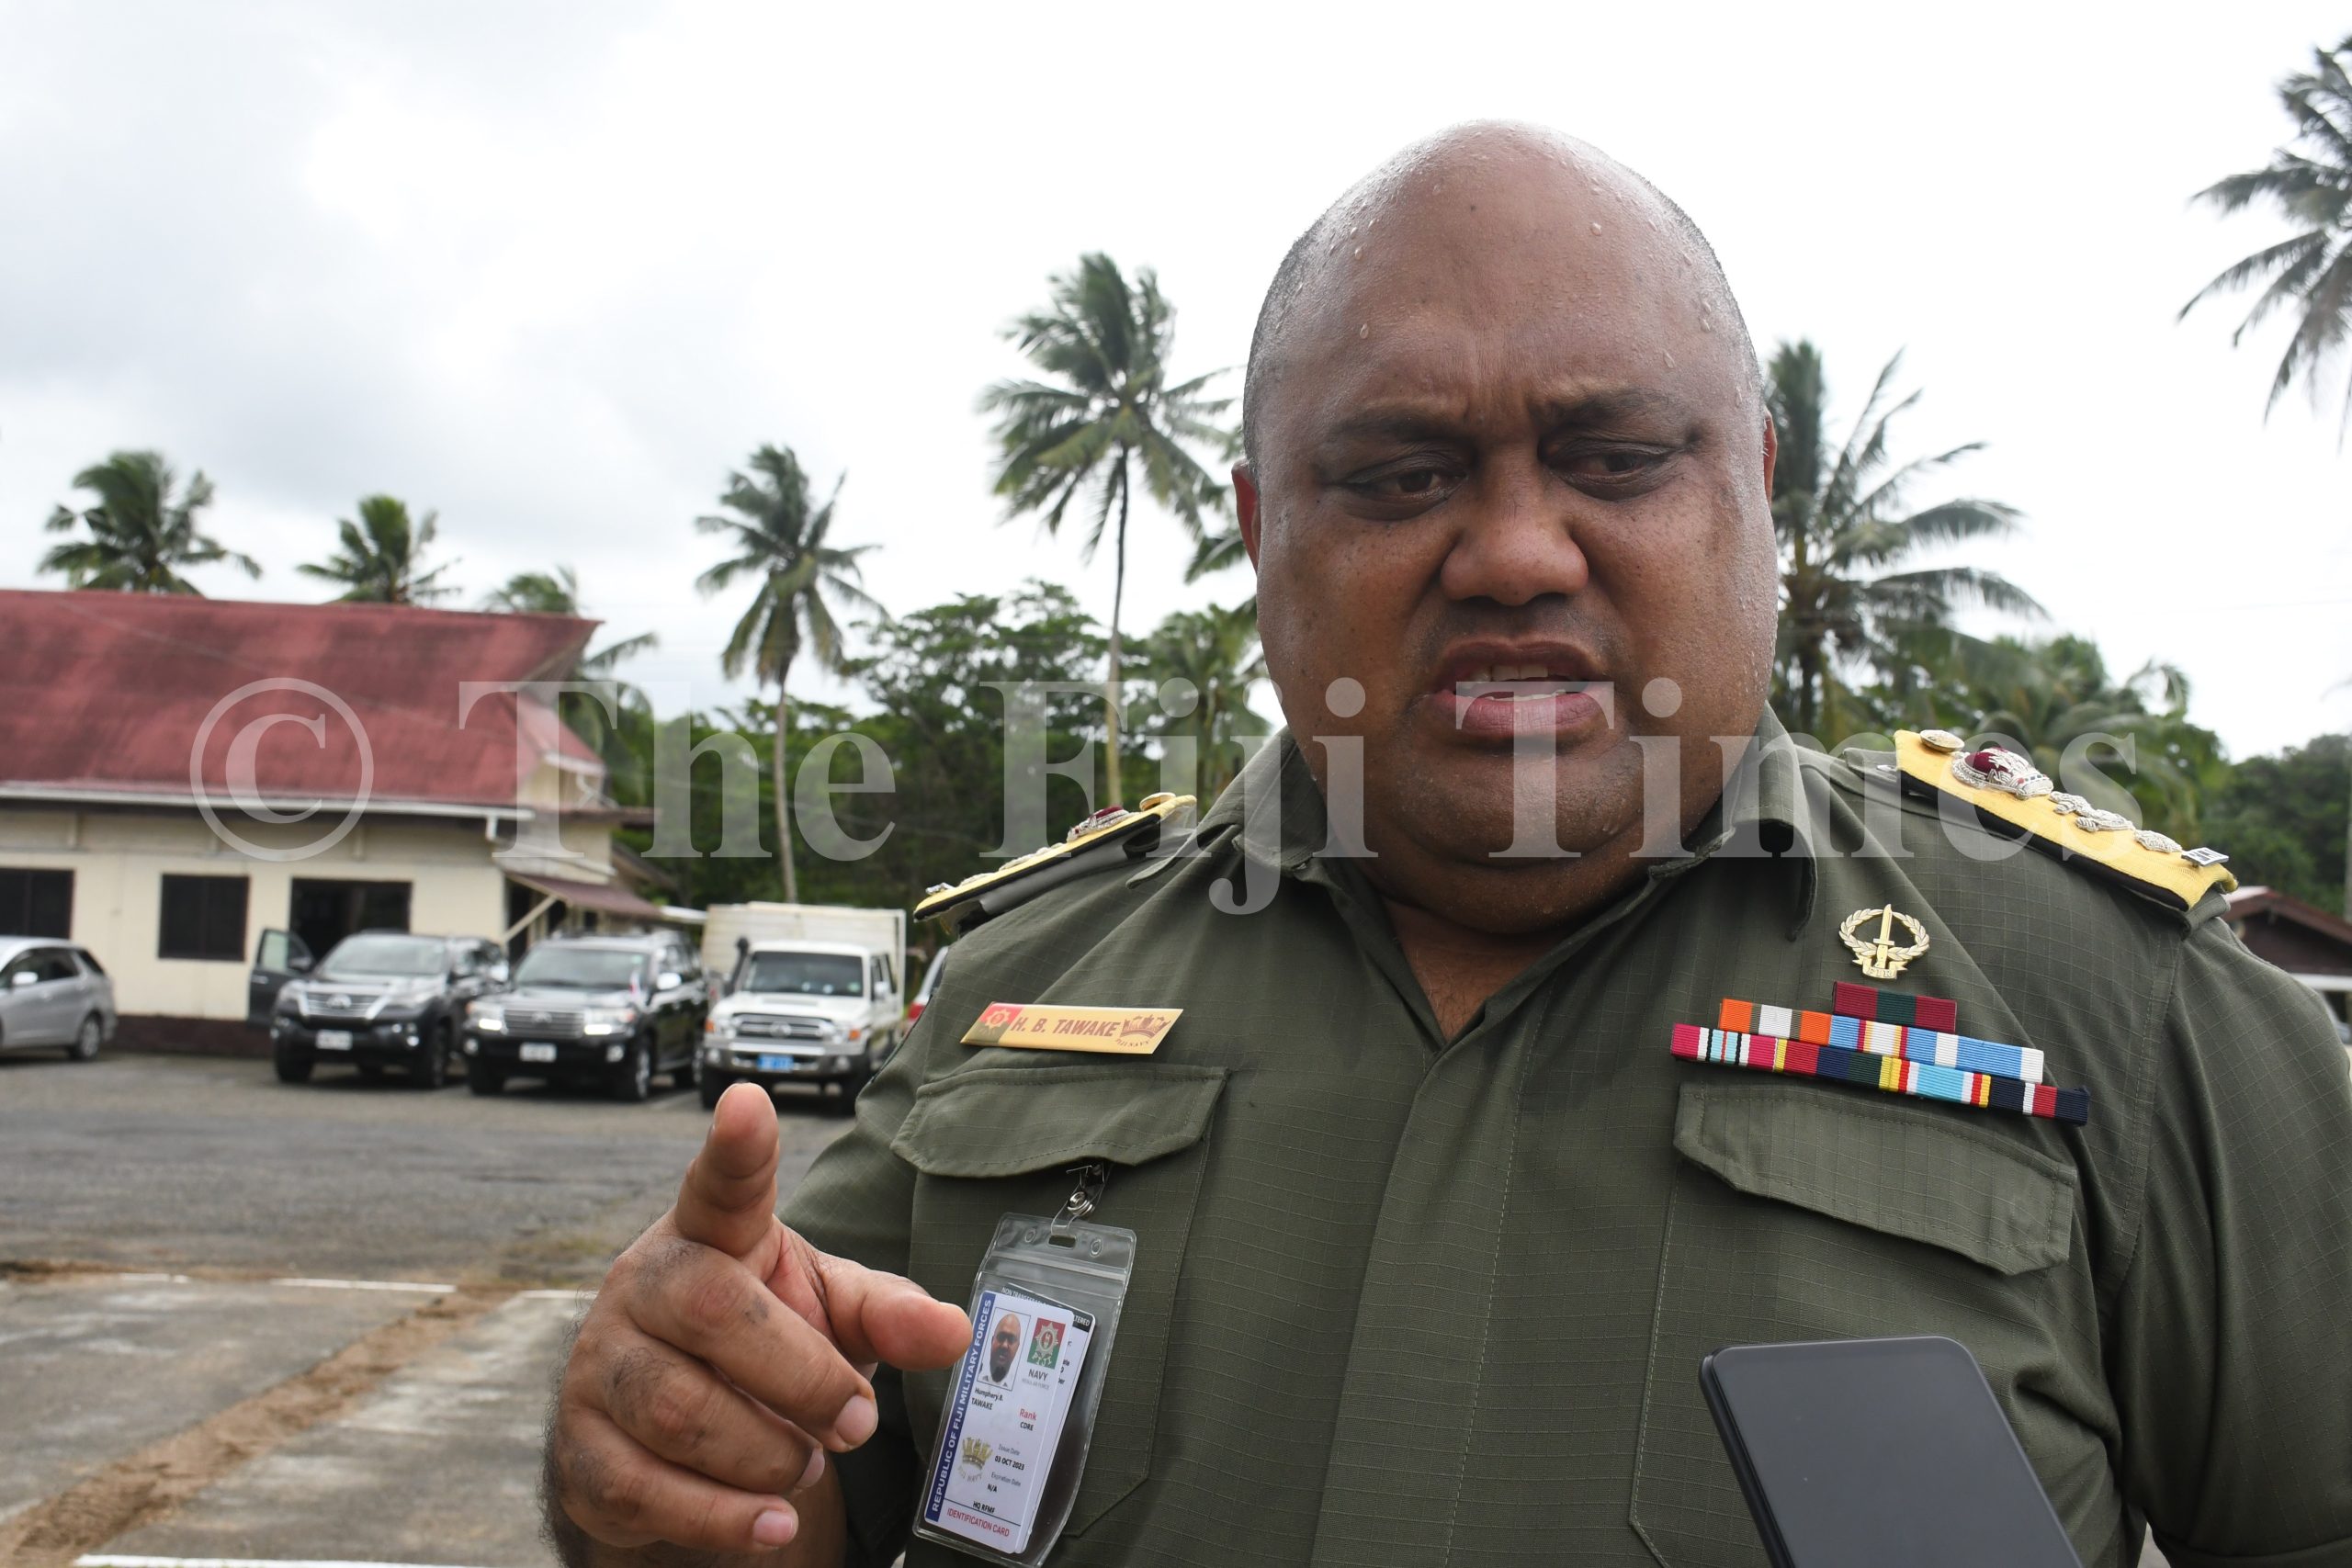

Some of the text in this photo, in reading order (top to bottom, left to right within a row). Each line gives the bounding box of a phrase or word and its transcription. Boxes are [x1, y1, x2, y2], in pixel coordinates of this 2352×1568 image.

[1031, 1018, 1047, 1032] B.
[1053, 1019, 1121, 1037] TAWAKE
[1029, 1369, 1048, 1382] NAVY
[933, 1300, 991, 1512] REPUBLIC OF FIJI MILITARY FORCES
[971, 1397, 993, 1411] TAWAKE
[1019, 1408, 1037, 1421] Rank
[1020, 1421, 1034, 1431] CDRE
[1001, 1457, 1012, 1466] OCT
[1012, 1461, 1024, 1471] 2023
[988, 1483, 997, 1493] N/A
[973, 1501, 981, 1511] HQ
[947, 1508, 1010, 1537] IDENTIFICATION CARD
